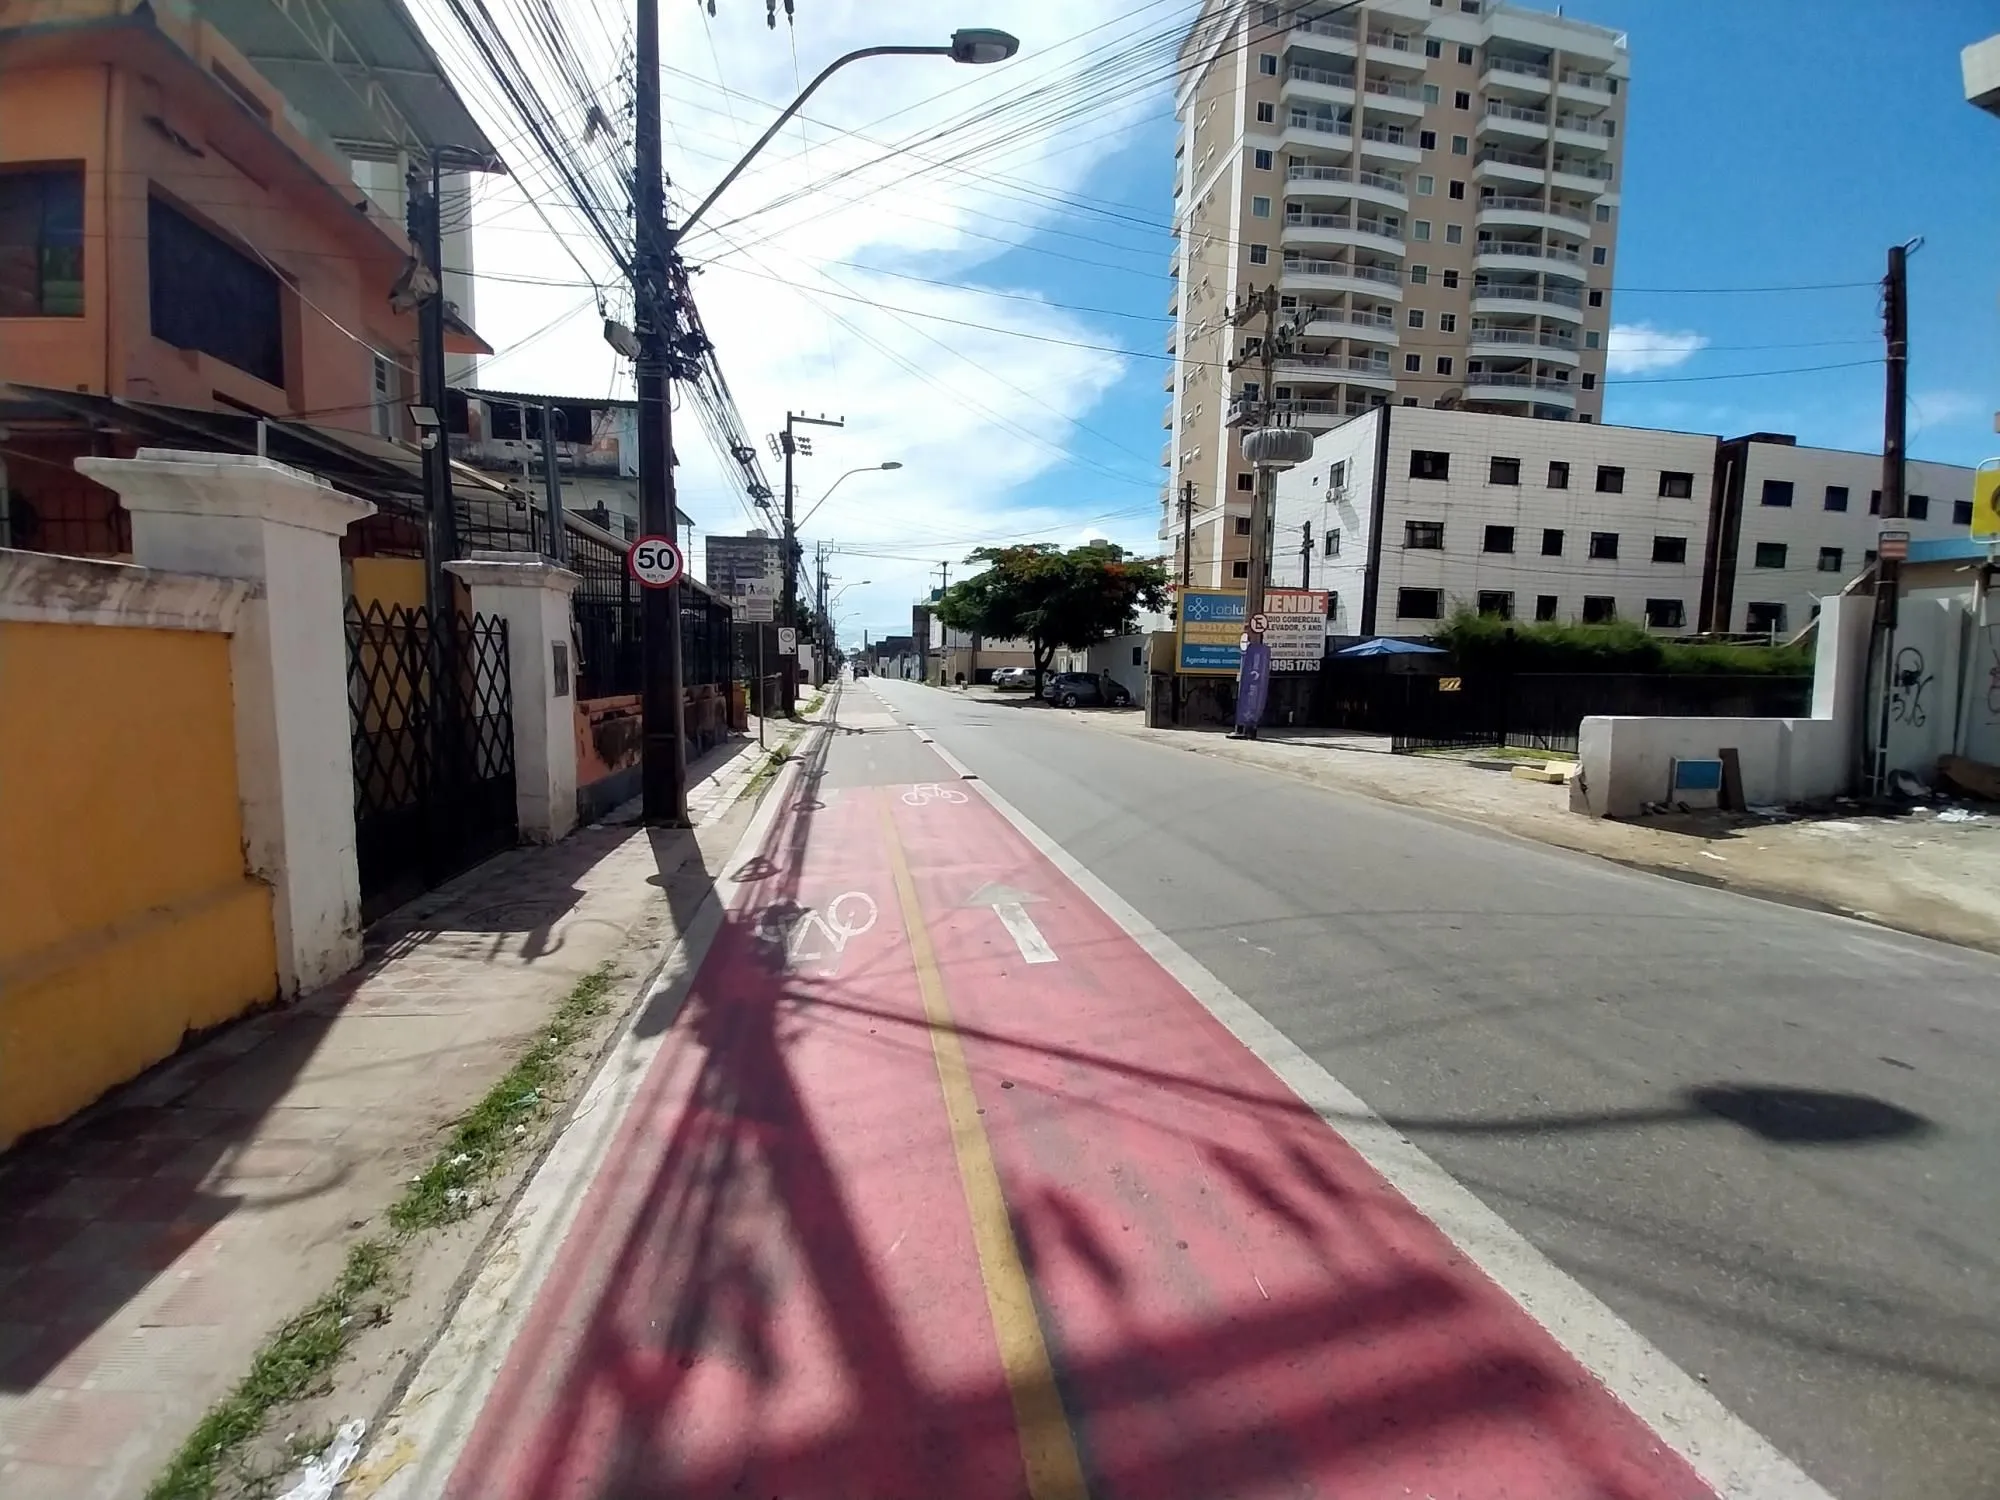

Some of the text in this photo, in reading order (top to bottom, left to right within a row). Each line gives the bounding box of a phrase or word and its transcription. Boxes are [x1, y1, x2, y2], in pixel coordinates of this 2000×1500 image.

[638, 547, 675, 570] 50
[1210, 603, 1246, 615] Lablu
[1282, 615, 1321, 623] COMERCIAL
[1269, 659, 1321, 671] 9951763
